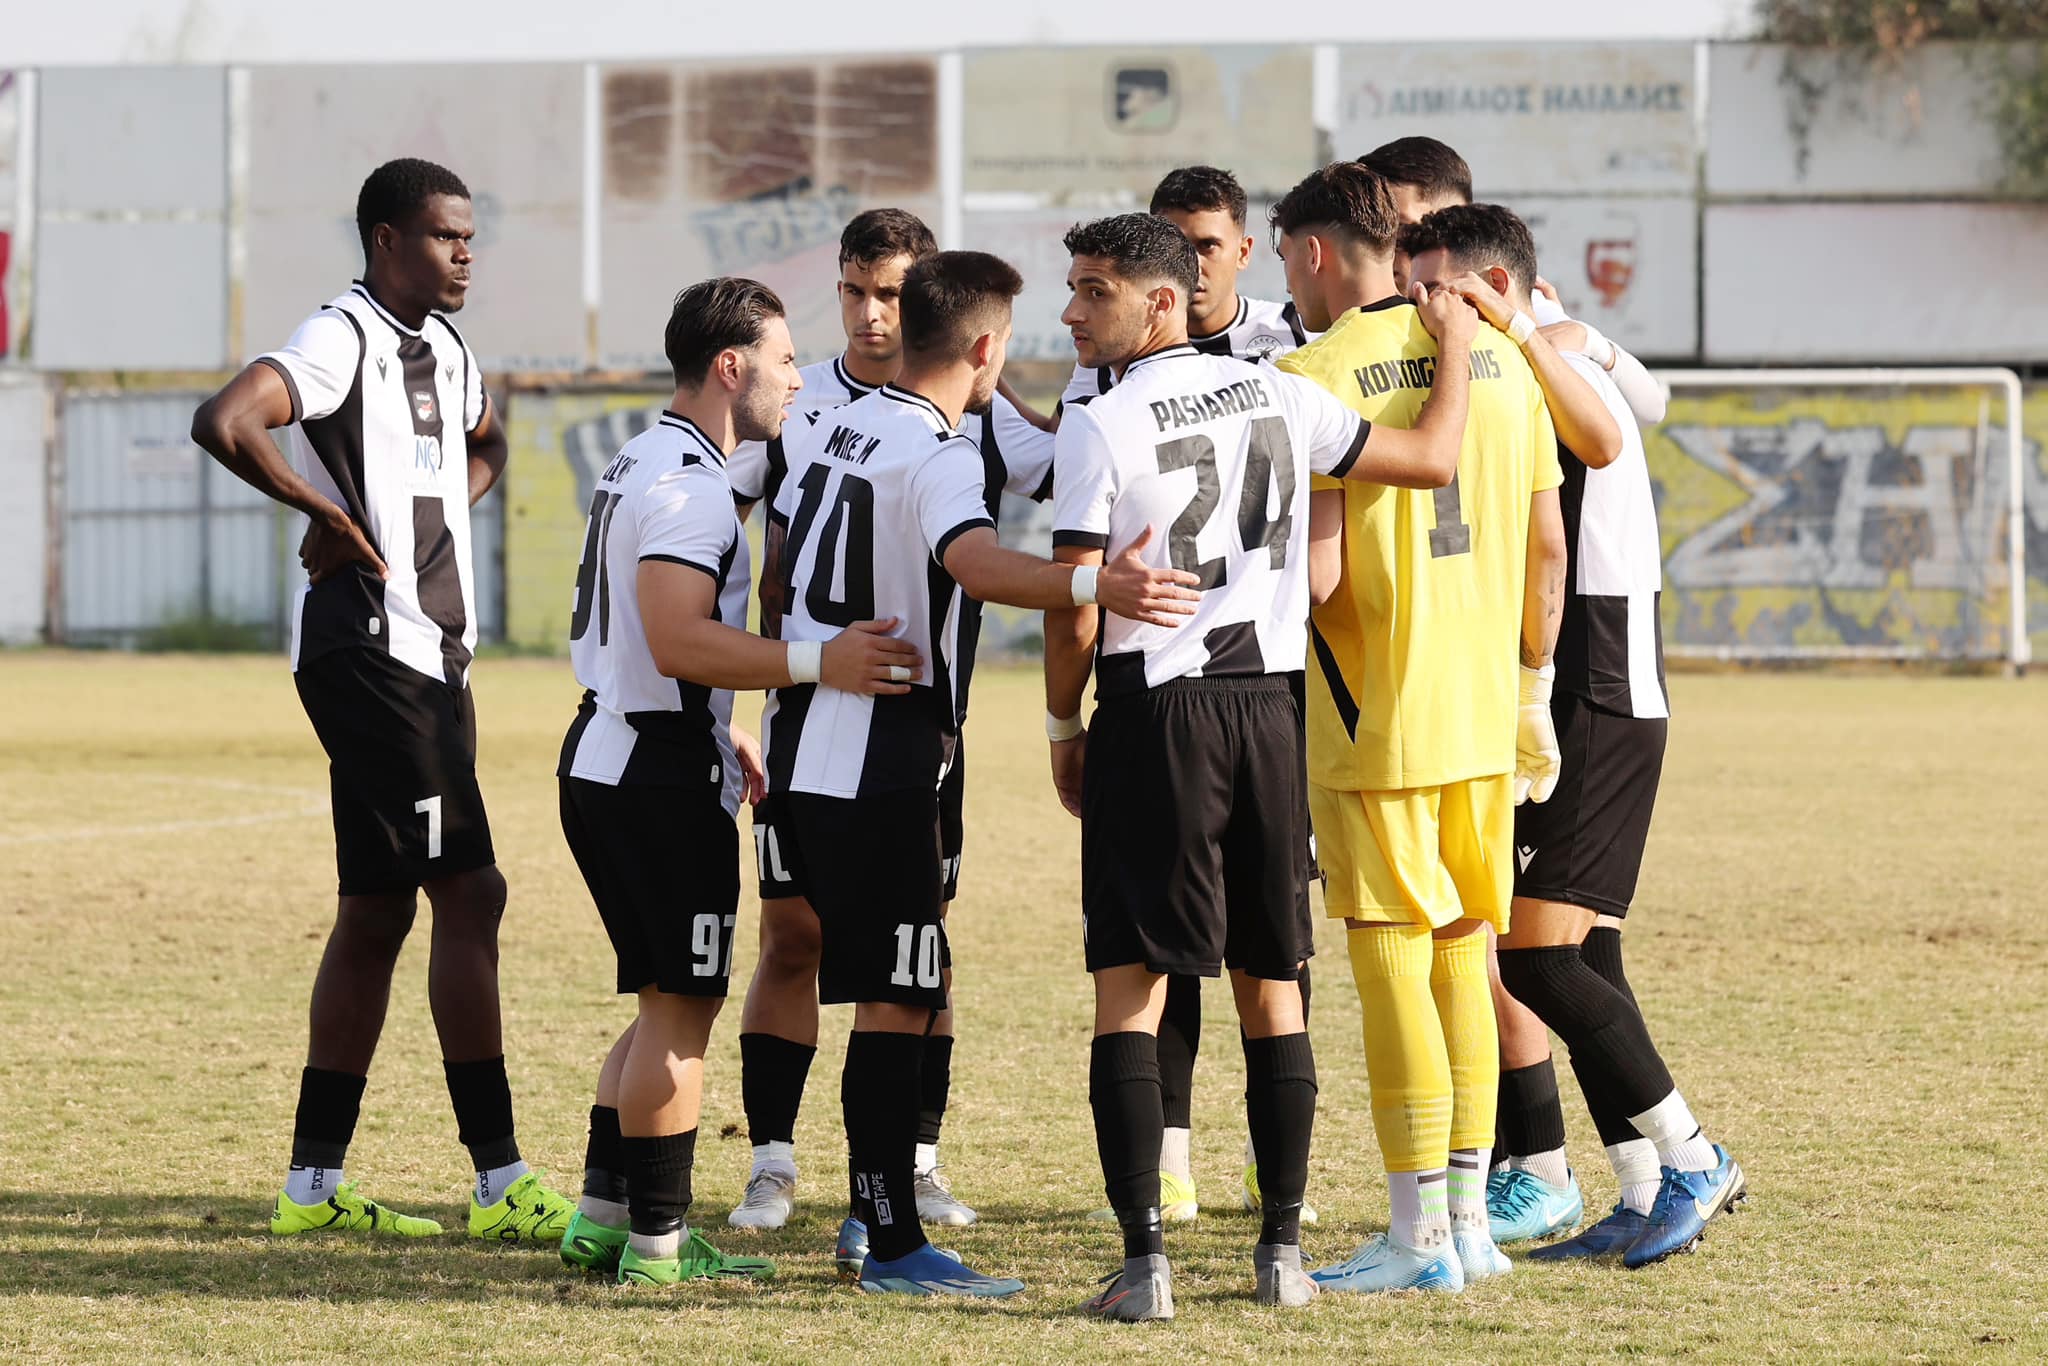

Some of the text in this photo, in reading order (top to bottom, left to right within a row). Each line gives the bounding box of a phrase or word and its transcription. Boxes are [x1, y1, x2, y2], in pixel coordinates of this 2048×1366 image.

[1150, 378, 1270, 432] PASIARDIS
[1354, 349, 1501, 398] KONTOGNIS
[1154, 415, 1296, 592] 24
[782, 461, 875, 628] 10
[691, 913, 737, 977] 97
[890, 923, 941, 989] 10
